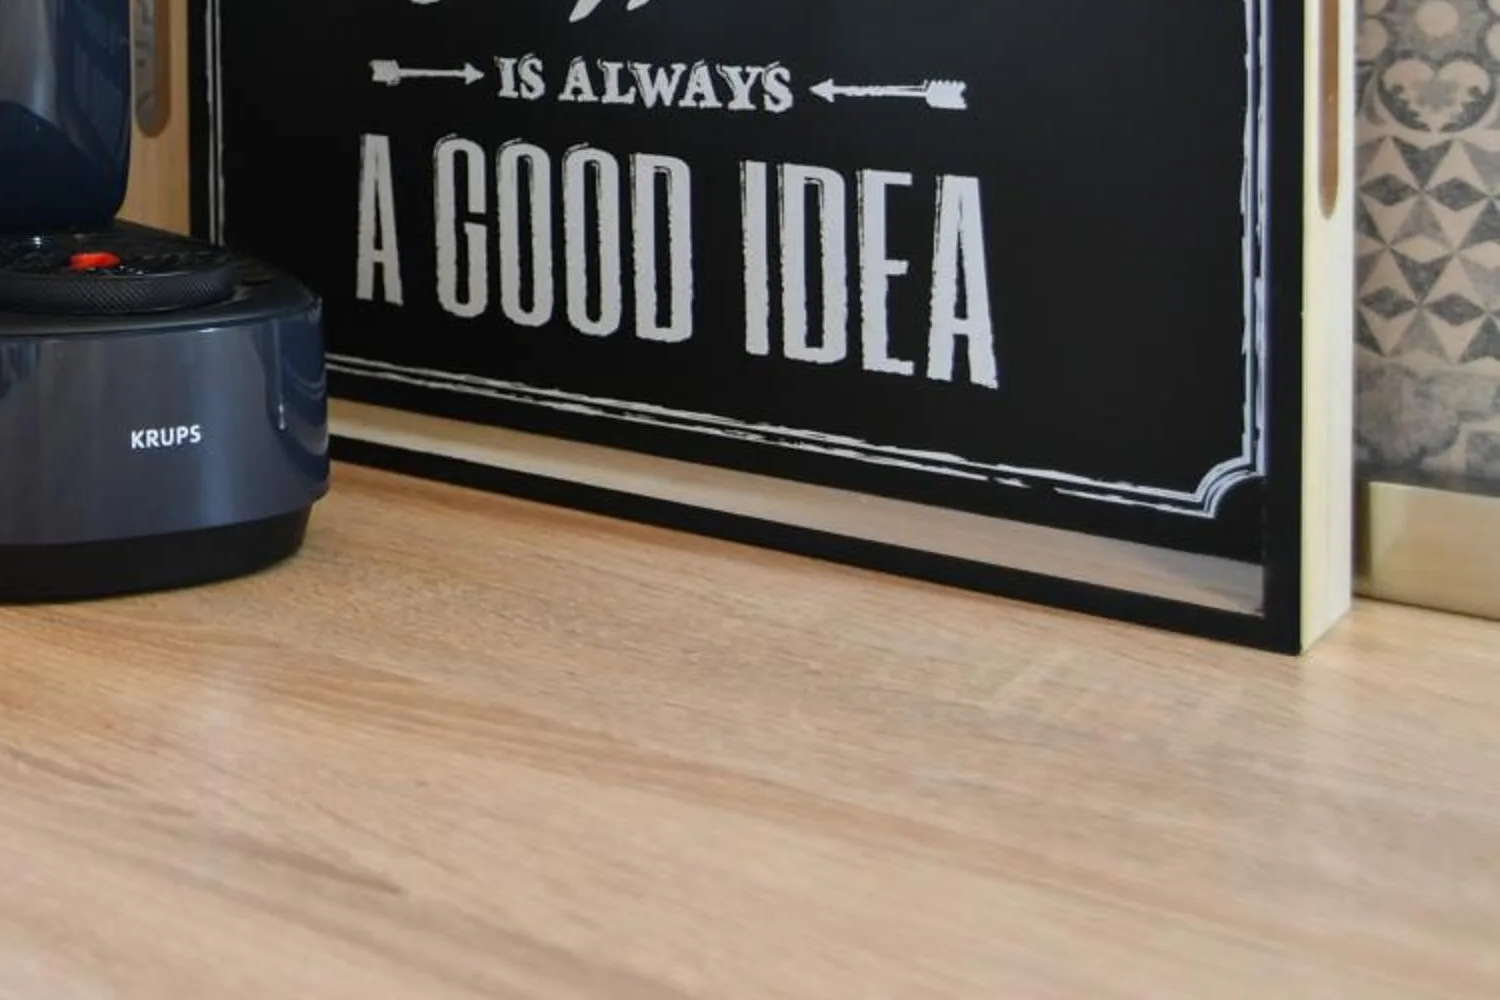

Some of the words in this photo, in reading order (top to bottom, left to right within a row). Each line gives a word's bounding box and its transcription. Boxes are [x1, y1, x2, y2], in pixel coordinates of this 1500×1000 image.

[495, 53, 544, 100] IS
[558, 55, 794, 113] ALWAYS
[355, 132, 404, 307] A
[433, 132, 694, 344] GOOD
[740, 159, 999, 390] IDEA
[130, 424, 202, 449] KRUPS
